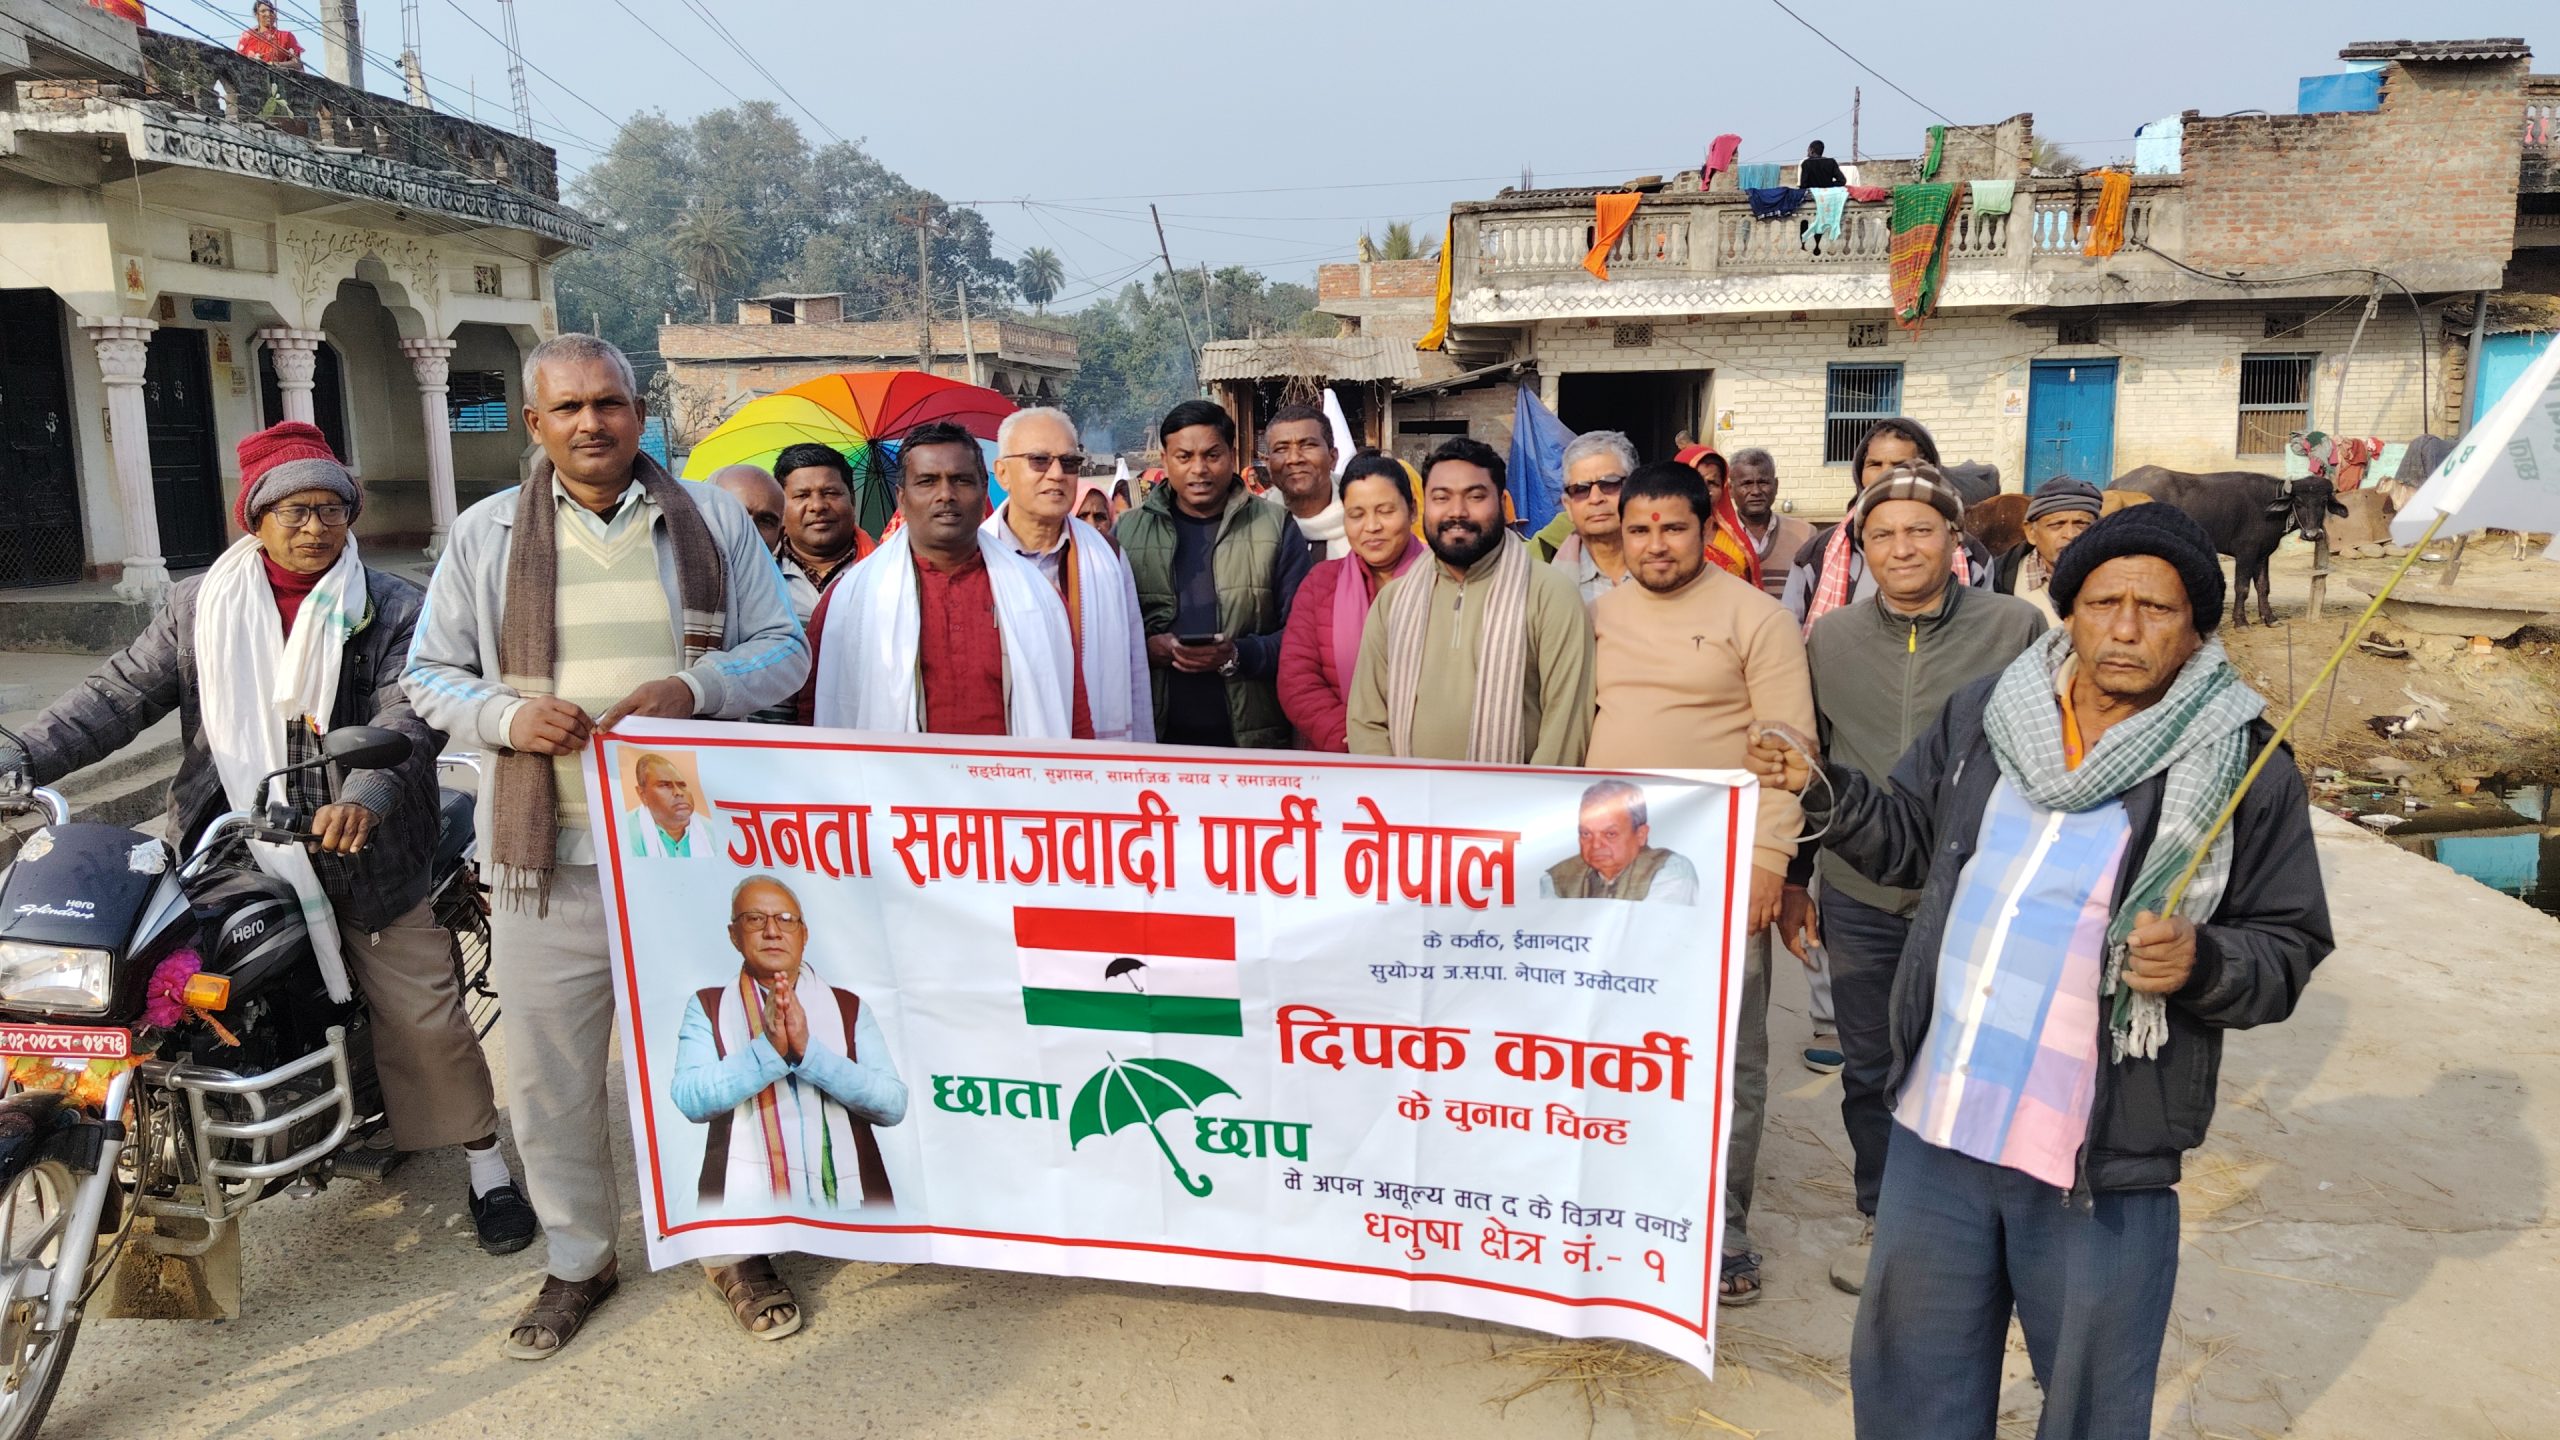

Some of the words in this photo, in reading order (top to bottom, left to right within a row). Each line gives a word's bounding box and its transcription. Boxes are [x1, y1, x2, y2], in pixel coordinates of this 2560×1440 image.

[1106, 763, 1171, 784] सामाजिक
[1177, 772, 1211, 785] न्याय
[1218, 772, 1229, 785] र
[1235, 773, 1303, 790] समाजवाद
[712, 800, 872, 877] जनता
[890, 789, 1180, 895] समाजवादी
[1199, 794, 1322, 897] पार्टी
[1342, 796, 1520, 911] नेपाल
[66, 899, 95, 910] Hero
[232, 919, 265, 944] Hero
[1423, 930, 1444, 949] के
[1451, 930, 1503, 950] कर्मठ,
[1512, 930, 1592, 953] ईमानदार
[1369, 961, 1436, 984] सुयोग्य
[1514, 962, 1566, 985] नेपाल
[1574, 970, 1658, 995] उम्मेदवार
[1276, 1004, 1471, 1072] दिपक
[1493, 1031, 1693, 1102] कार्की
[931, 1074, 1060, 1120] छाता
[1398, 1090, 1430, 1120] के
[1444, 1100, 1534, 1133] चुनाव
[1544, 1104, 1632, 1145] चिन्ह
[1194, 1116, 1311, 1163] छाप
[1284, 1168, 1303, 1190] मे
[1313, 1176, 1364, 1196] अपन
[1374, 1181, 1445, 1209] अमूल्य
[1454, 1190, 1492, 1211] मत
[1502, 1196, 1518, 1217] द
[1529, 1195, 1552, 1219] के
[1562, 1201, 1624, 1227] विजय
[1364, 1212, 1463, 1261] धनुषा
[1480, 1216, 1546, 1264] क्षेत्र
[1643, 1250, 1666, 1282] १
